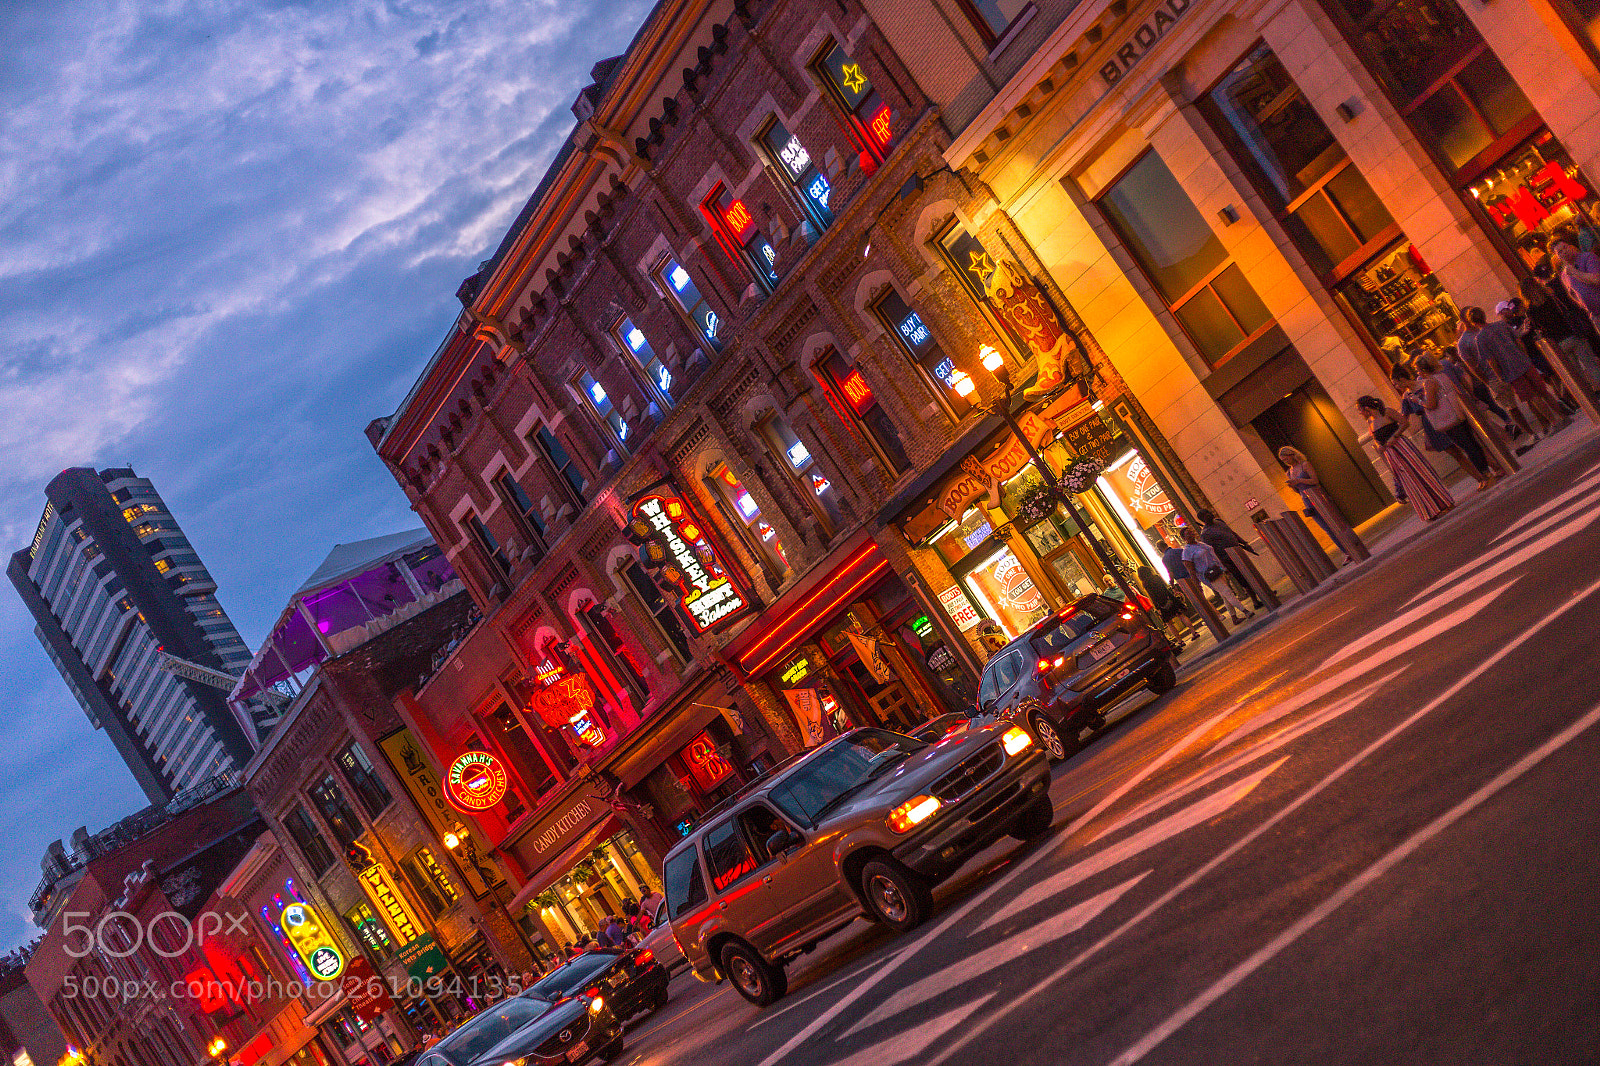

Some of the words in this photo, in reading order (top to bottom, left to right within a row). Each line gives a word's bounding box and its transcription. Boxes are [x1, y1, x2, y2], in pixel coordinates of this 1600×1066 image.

[1099, 0, 1190, 85] BROAD
[780, 139, 800, 163] BUY
[790, 149, 810, 174] PAIR
[809, 181, 824, 199] GET
[900, 317, 916, 336] BUY
[913, 313, 921, 323] 1
[910, 326, 927, 345] PAIR
[934, 361, 950, 379] GET
[1068, 430, 1081, 441] BUY
[1079, 424, 1091, 435] ONE
[1088, 416, 1102, 429] PAIR
[1078, 445, 1089, 456] GET
[1087, 438, 1100, 449] TWO
[1098, 430, 1112, 442] PAIR
[946, 477, 978, 513] BOOT
[990, 417, 1039, 479] COUNRY
[1140, 467, 1150, 478] ON
[1146, 485, 1160, 498] YOU
[1163, 503, 1173, 511] PA
[1245, 498, 1258, 510] FDC
[639, 498, 711, 593] WHISKEY
[1006, 568, 1016, 579] ONE
[688, 583, 735, 616] BENT
[941, 588, 960, 603] BOOTS
[1012, 587, 1022, 597] YOU
[1022, 579, 1032, 589] GET
[700, 597, 743, 628] Saloon
[952, 605, 977, 626] FREE
[937, 657, 955, 672] SALOO
[452, 753, 494, 784] SAVANNAH'S
[418, 772, 455, 826] ROOF
[459, 792, 486, 807] CANDY
[488, 770, 505, 802] KITCHEN
[533, 826, 560, 854] CANDY
[556, 799, 592, 834] KITCHEN
[398, 943, 420, 960] Korean
[403, 953, 417, 965] Vets
[416, 940, 437, 957] Bridge
